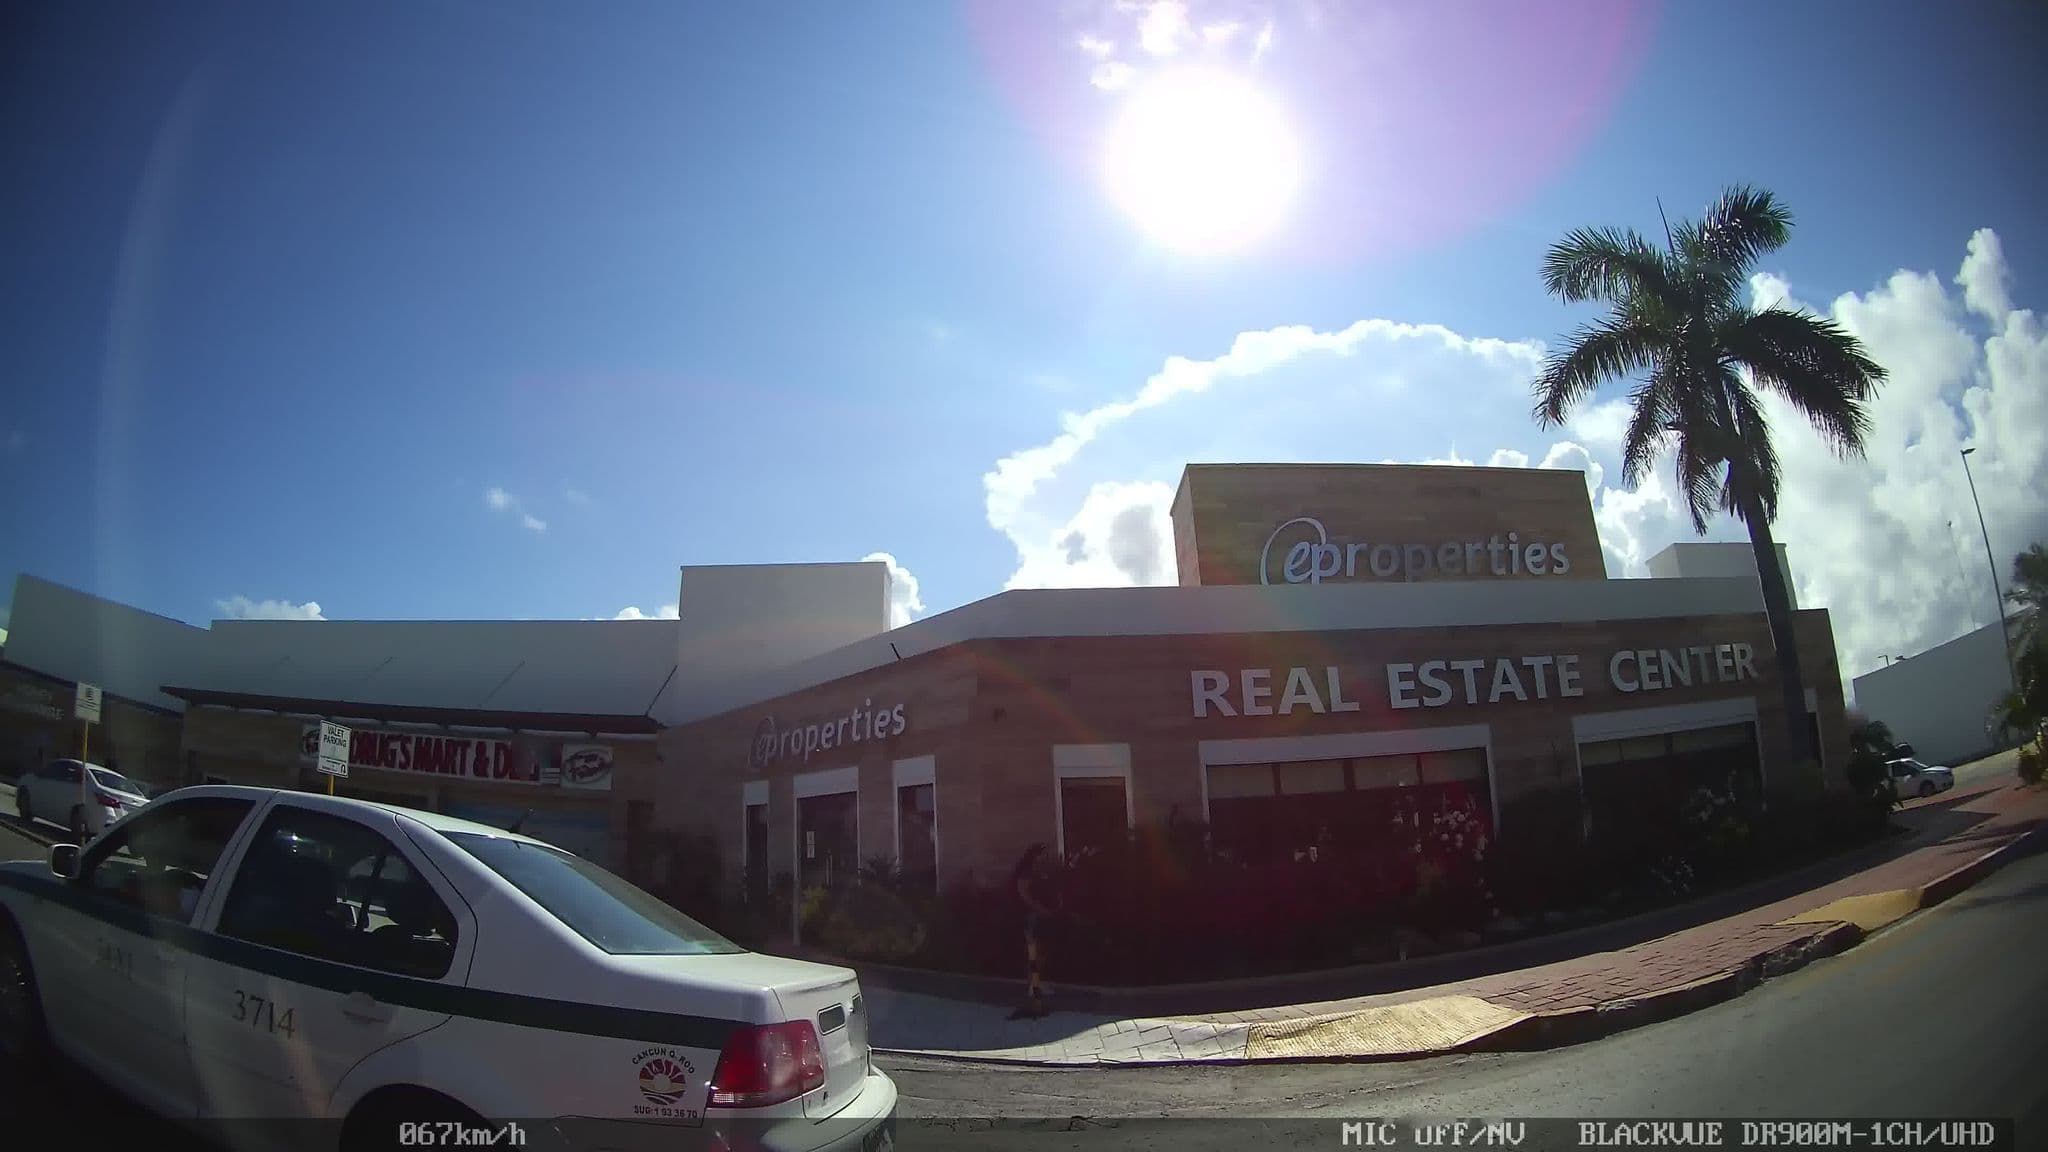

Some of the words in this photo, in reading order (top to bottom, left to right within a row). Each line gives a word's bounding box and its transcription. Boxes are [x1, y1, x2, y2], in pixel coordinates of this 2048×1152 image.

[1190, 666, 1360, 718] REAL
[1386, 654, 1584, 710] ESTATE
[1609, 642, 1758, 692] CENTER
[323, 735, 347, 748] PARKING
[327, 725, 344, 738] VALET
[413, 736, 472, 777] MART
[473, 741, 490, 779] &
[232, 989, 295, 1040] 3714
[632, 1047, 667, 1064] CANCUN
